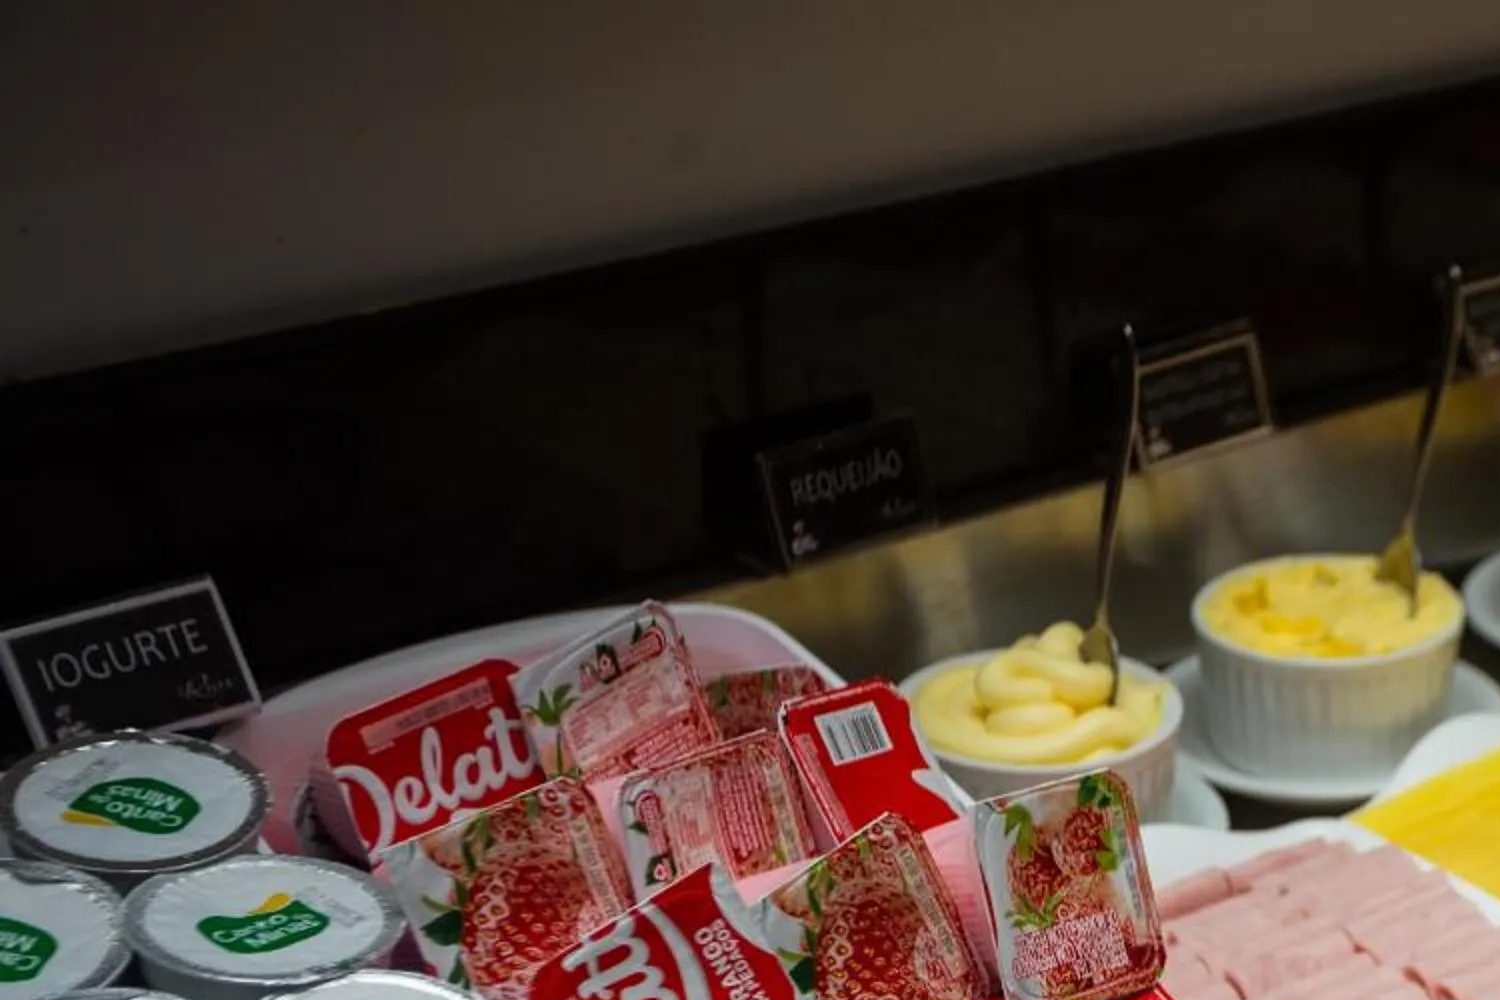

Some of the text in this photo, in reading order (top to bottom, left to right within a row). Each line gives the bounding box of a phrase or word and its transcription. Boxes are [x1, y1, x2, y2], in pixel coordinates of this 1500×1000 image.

[36, 618, 209, 692] IOGURTE
[104, 801, 184, 827] Canto
[106, 785, 184, 812] Minas
[712, 917, 760, 992] PEDAÇOS
